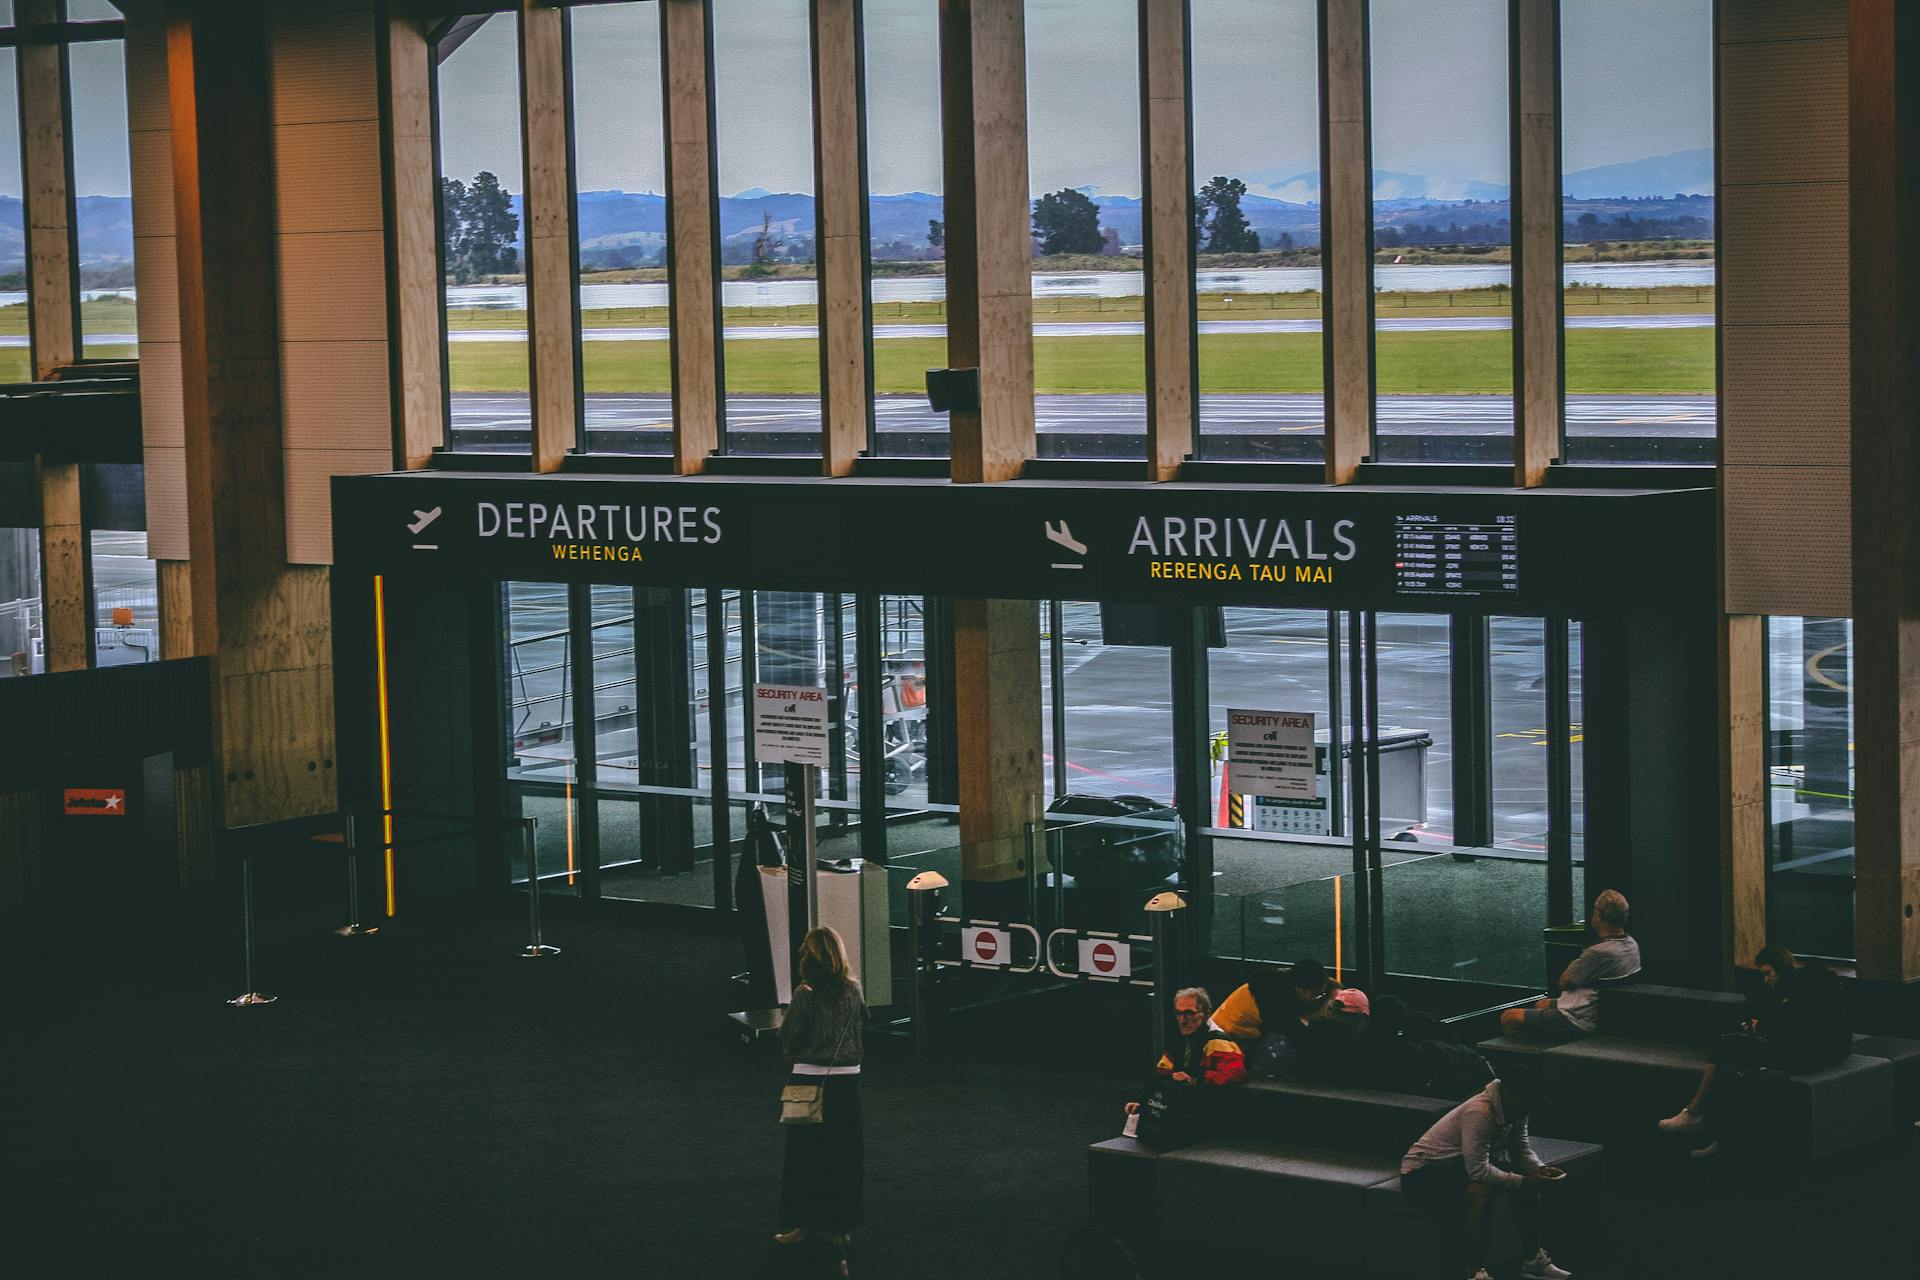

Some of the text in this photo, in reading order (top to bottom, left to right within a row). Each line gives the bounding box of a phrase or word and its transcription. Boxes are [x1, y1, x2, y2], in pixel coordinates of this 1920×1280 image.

[478, 502, 722, 544] DEPARTURES
[1127, 516, 1357, 561] ARRIVALS
[552, 544, 643, 562] WEHENGA
[1151, 562, 1333, 584] RERENGA TAU MAI
[757, 688, 823, 702] SECURITY AREA
[1231, 715, 1310, 729] SECURITY AREA
